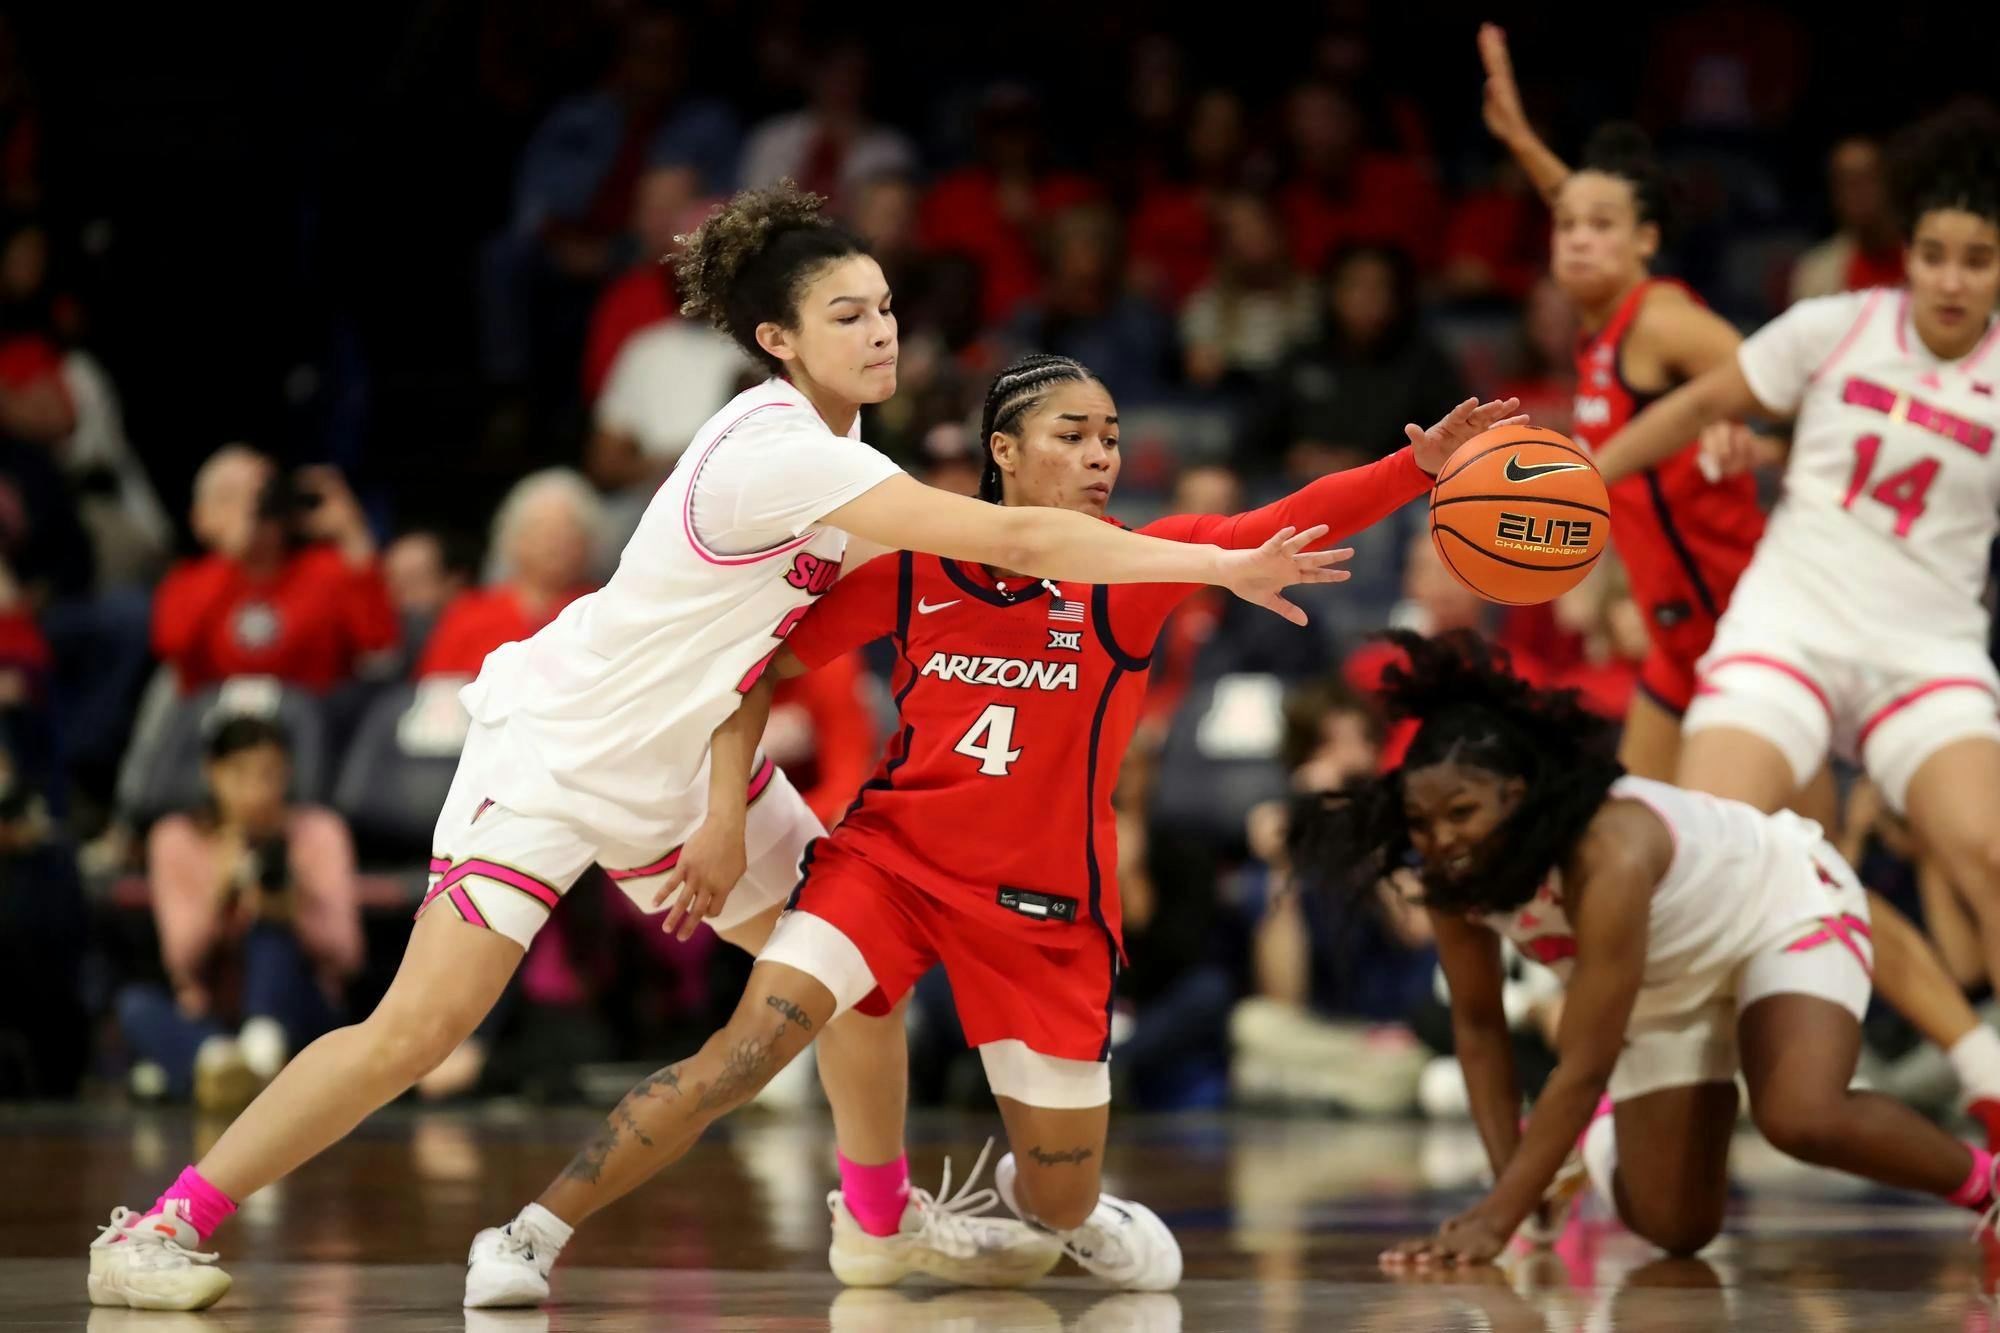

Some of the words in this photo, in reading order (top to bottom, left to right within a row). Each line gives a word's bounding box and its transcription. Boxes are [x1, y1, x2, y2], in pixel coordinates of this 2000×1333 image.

[1841, 433, 1942, 538] 14
[1497, 512, 1592, 546] ELITE
[1496, 540, 1588, 555] CHAMPIONSHIP
[1047, 629, 1082, 652] XII
[920, 652, 1079, 691] ARIZONA
[953, 704, 1023, 776] 4
[1051, 902, 1066, 913] 42
